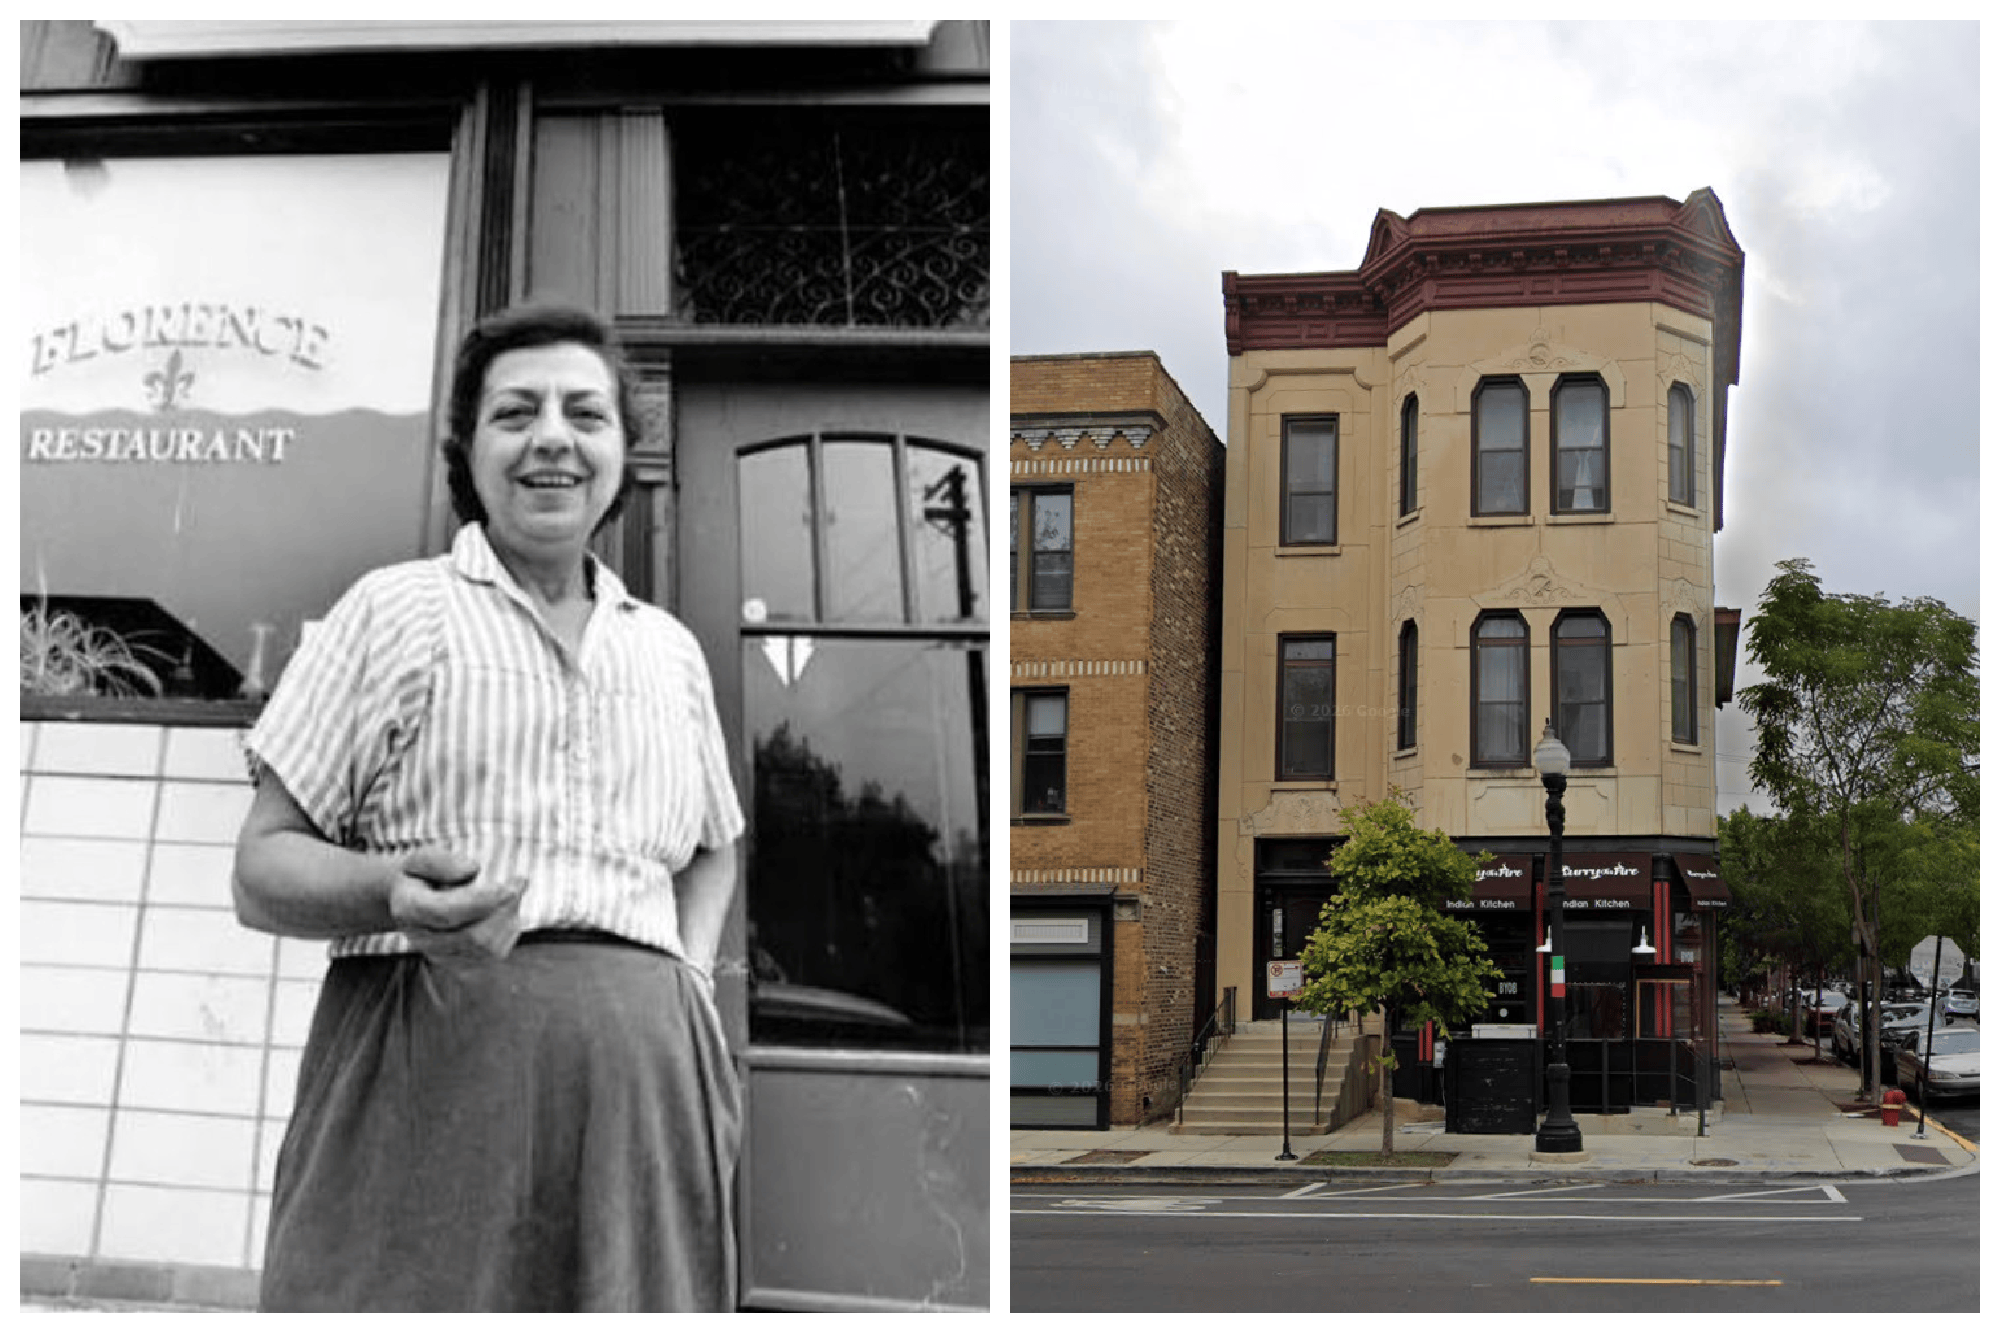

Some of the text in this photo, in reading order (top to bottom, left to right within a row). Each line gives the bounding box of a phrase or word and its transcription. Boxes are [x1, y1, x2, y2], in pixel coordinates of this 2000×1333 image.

[31, 301, 331, 376] FLORENCE
[28, 426, 296, 464] RESTAURANT
[1480, 899, 1515, 909] Kitchen
[1562, 899, 1630, 909] ndian Kitchen
